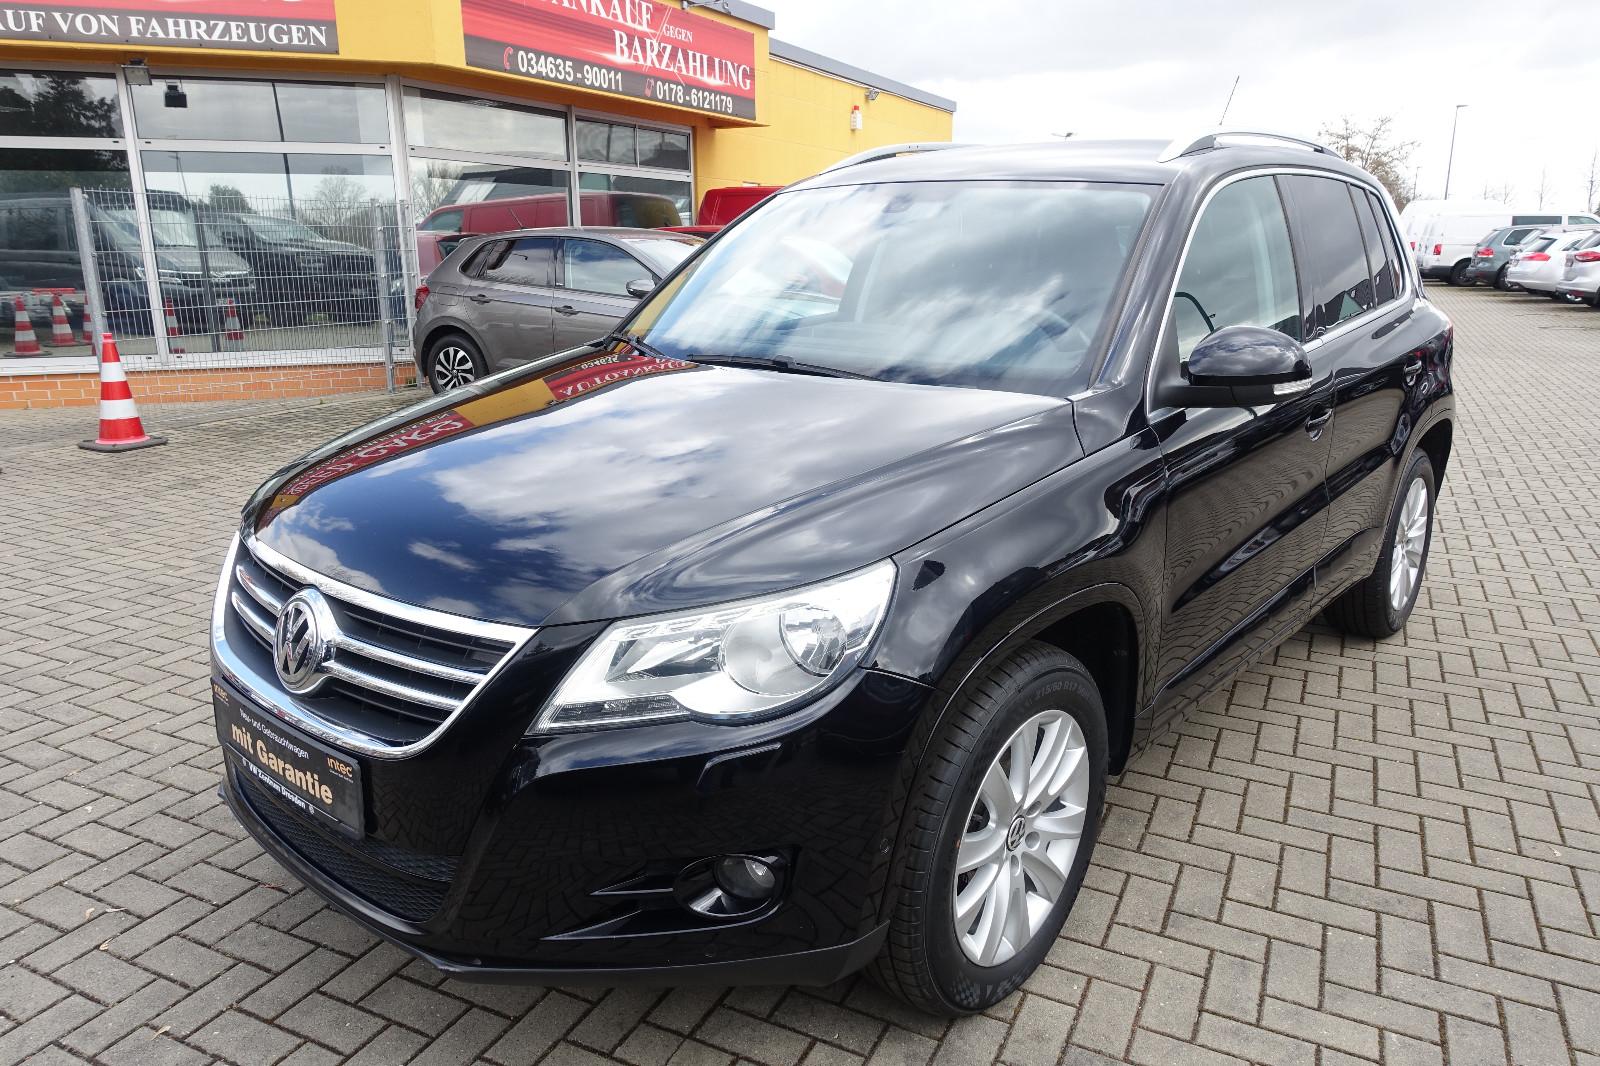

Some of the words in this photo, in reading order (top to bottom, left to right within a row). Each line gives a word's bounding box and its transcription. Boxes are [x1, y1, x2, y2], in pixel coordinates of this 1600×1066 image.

[0, 9, 46, 32] UF
[50, 11, 120, 37] VON
[129, 16, 327, 47] FAHRZEUGEN
[663, 23, 693, 44] GEGEN
[613, 29, 751, 90] BARZAHLUNG
[231, 723, 254, 755] mit
[256, 739, 333, 805] Garantie
